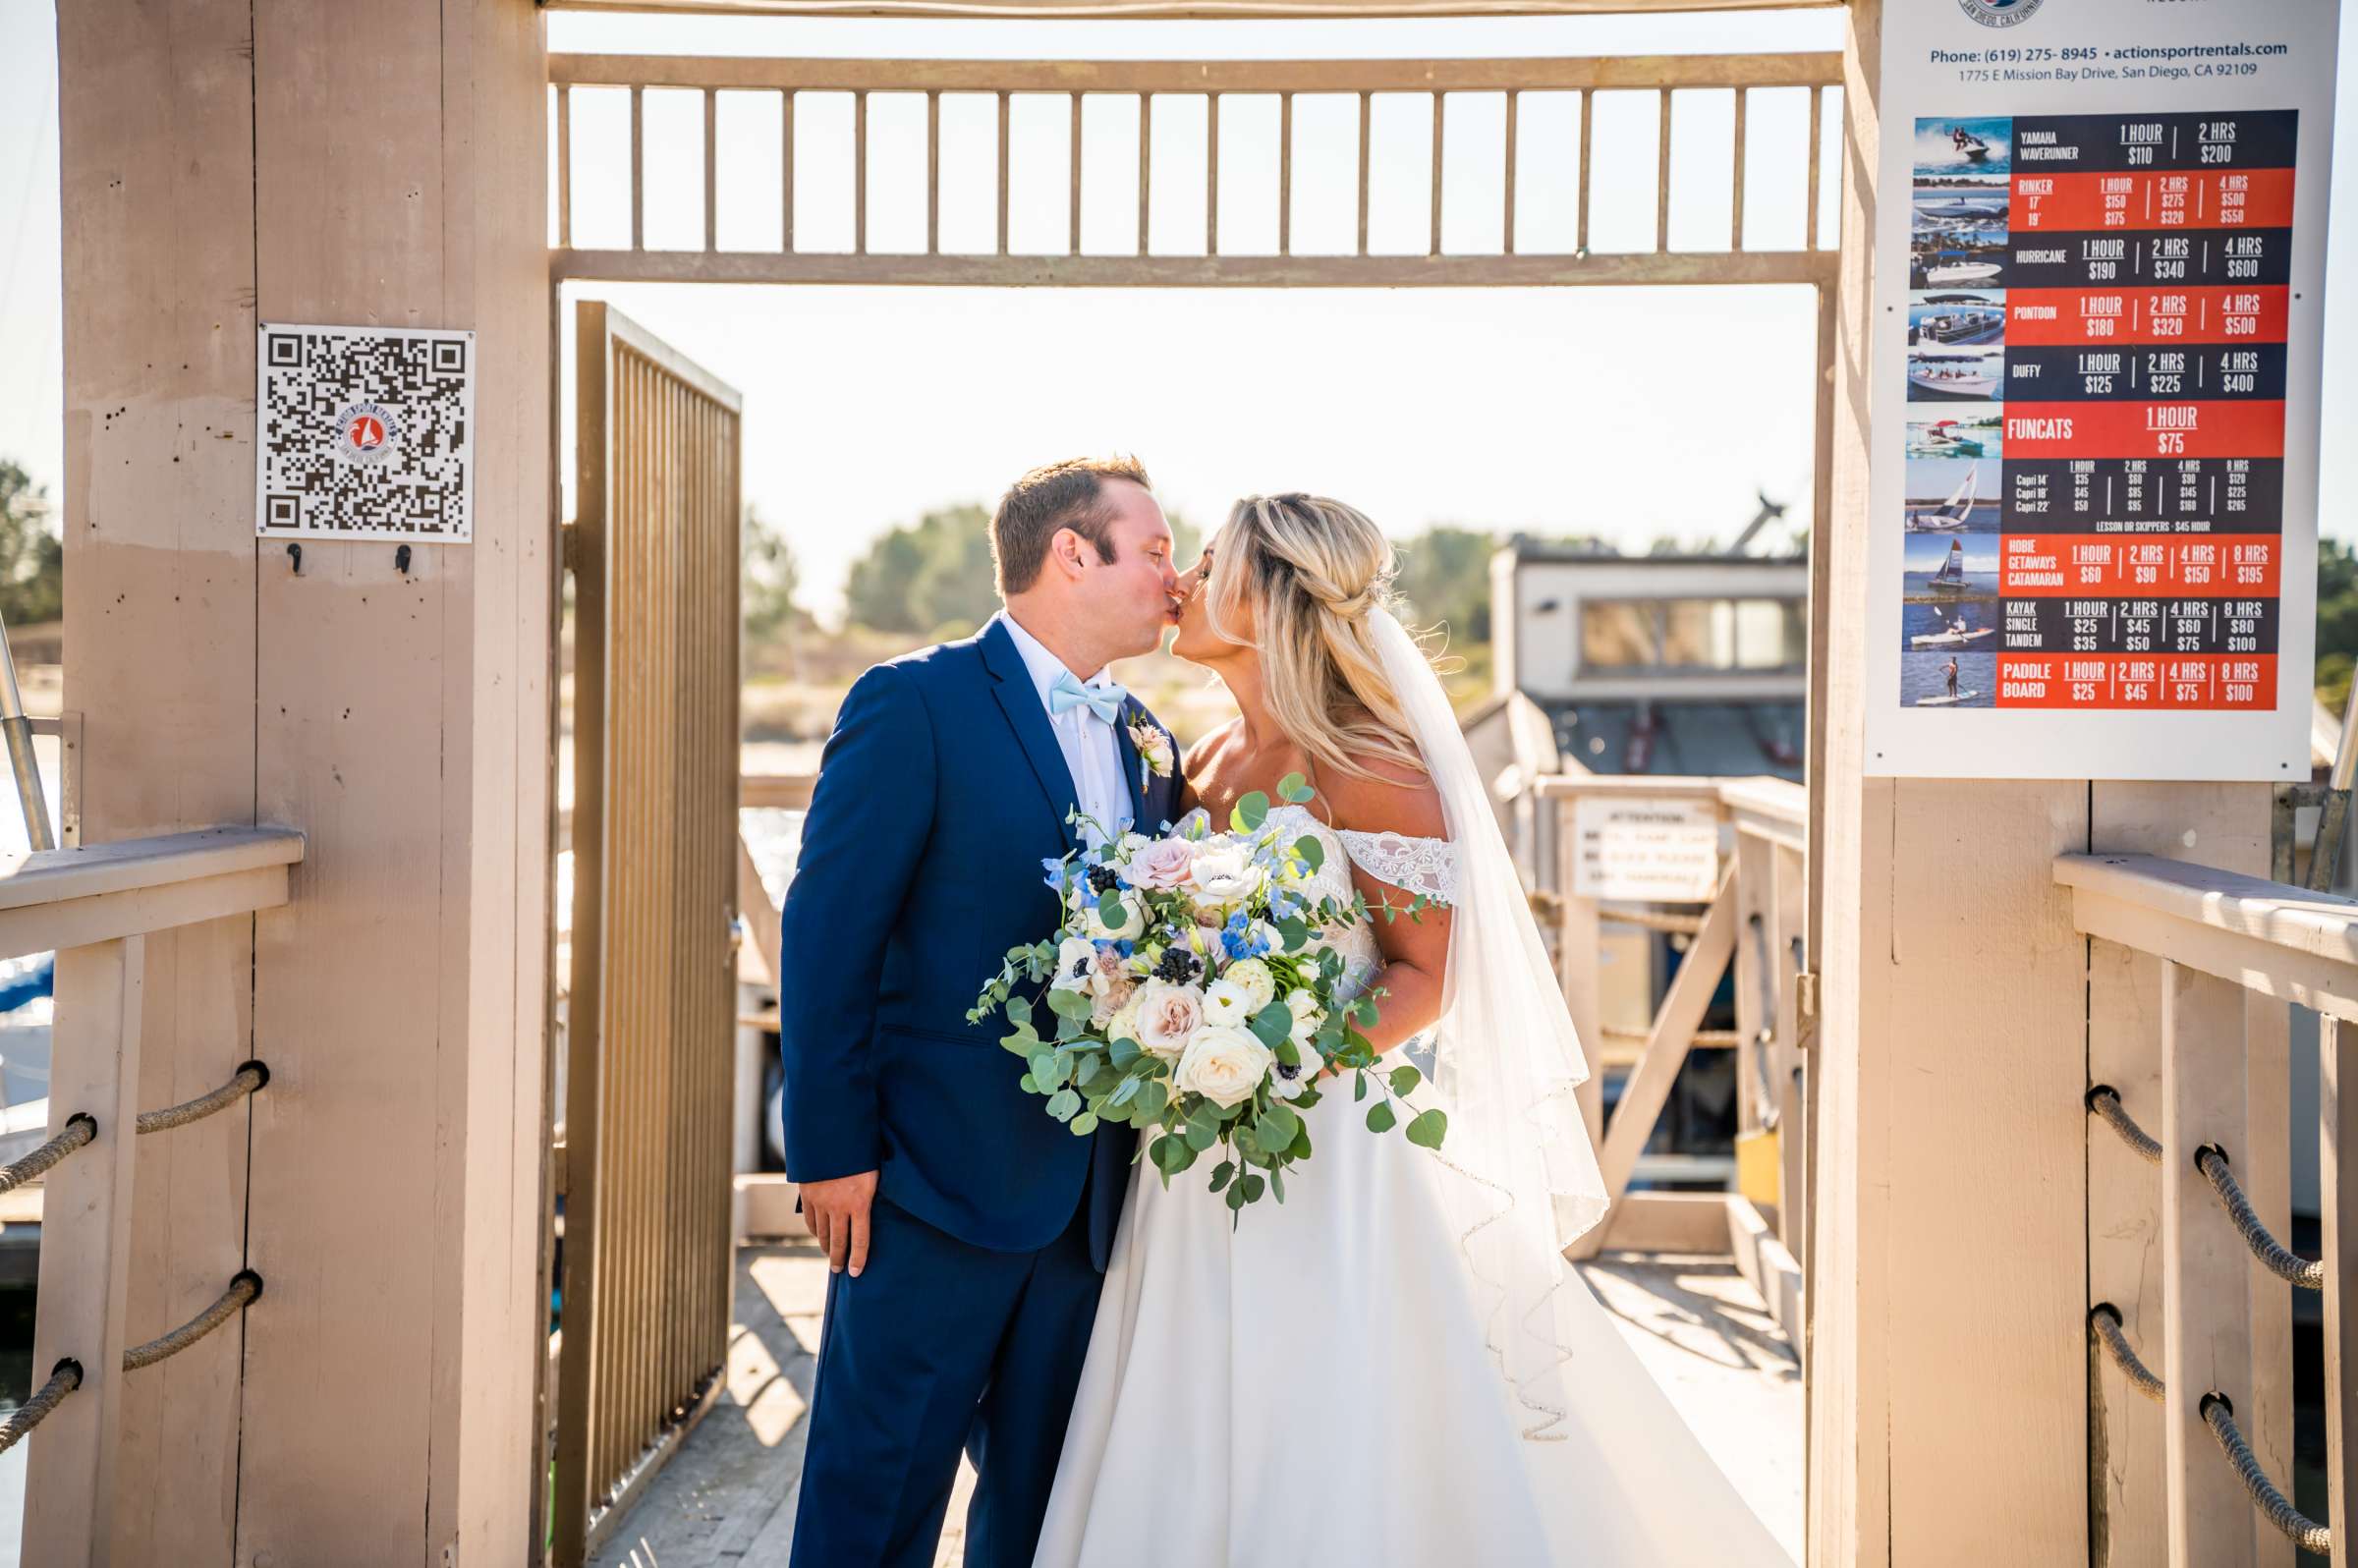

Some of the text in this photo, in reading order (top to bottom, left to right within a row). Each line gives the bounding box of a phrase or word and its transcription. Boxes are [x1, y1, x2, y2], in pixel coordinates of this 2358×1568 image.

[1930, 42, 2287, 63] Phone: (619) 275- 8945 actionsportrentals.com
[1959, 69, 1990, 82] 1775
[2003, 67, 2052, 81] Mission
[2055, 67, 2078, 82] Bay
[2081, 66, 2118, 81] Drive,
[2121, 65, 2146, 78] San
[2149, 64, 2190, 81] Diego,
[2194, 64, 2213, 77] CA
[2217, 64, 2257, 76] 92109
[2021, 132, 2056, 144] YAMAHA
[2121, 125, 2162, 142] 1 HOUR
[2199, 123, 2235, 140] 2 HRS
[2020, 147, 2078, 160] WAVERUNNER
[2129, 147, 2153, 165] $110
[2201, 145, 2231, 163] $200
[2019, 180, 2052, 193] RINKER
[2107, 178, 2132, 192] HOUR
[2161, 177, 2188, 191] 2 HRS
[2220, 176, 2248, 190] 4 HRS
[2029, 196, 2041, 209] 17'
[2105, 195, 2126, 208] $150
[2162, 194, 2184, 207] $275
[2221, 193, 2244, 206] $500
[2028, 212, 2041, 226] 19'
[2105, 212, 2125, 226] $175
[2161, 210, 2184, 224] $320
[2220, 209, 2243, 223] $550
[2083, 241, 2124, 257] 1 HOUR
[2153, 240, 2189, 256] 2 HRS
[2225, 238, 2262, 254] 4 HRS
[2016, 250, 2066, 263] HURRICANE
[2089, 262, 2115, 279] $190
[2155, 261, 2184, 278] $340
[2228, 260, 2258, 277] $600
[2081, 297, 2122, 314] 1 HOUR
[2150, 297, 2186, 313] 2 HRS
[2223, 295, 2260, 311] 4 HRS
[2015, 307, 2056, 319] PONTOON
[2087, 319, 2113, 337] $180
[2153, 318, 2182, 336] $320
[2225, 317, 2256, 335] $500
[2079, 355, 2120, 371] 1 HOUR
[2148, 354, 2185, 370] 2 HRS
[2221, 353, 2258, 369] 4 HRS
[2013, 364, 2041, 378] DUFFY
[2085, 376, 2112, 393] $125
[2151, 375, 2180, 392] $225
[2223, 375, 2254, 392] $400
[2147, 408, 2197, 427] 1 HOUR
[2008, 419, 2073, 439] FUNCATS
[2159, 434, 2184, 454] $75
[2075, 461, 2095, 472] HOUR
[2133, 461, 2147, 472] HRS
[2186, 461, 2200, 472] HRS
[2234, 461, 2249, 472] HRS
[2097, 521, 2210, 532] LESSON OR SKIPPERS $45 HOUR
[2009, 539, 2035, 553] HOBIE
[2072, 546, 2110, 562] 1 HOUR
[2130, 546, 2163, 562] 2 HRS
[2181, 546, 2215, 562] 4 HRS
[2234, 546, 2268, 562] 8 HRS
[2008, 557, 2056, 570] GETAWAYS
[2008, 573, 2063, 587] CATAMARAN
[2081, 567, 2101, 584] $60
[2136, 567, 2157, 584] $90
[2185, 567, 2210, 584] $150
[2238, 567, 2263, 584] $195
[2006, 602, 2036, 614] KAYAK
[2065, 602, 2107, 616] 1 HOUR
[2120, 602, 2158, 616] 2 HRS
[2170, 602, 2208, 616] 4 HRS
[2224, 602, 2262, 616] 8 HRS
[2006, 618, 2037, 631] SINGLE
[2074, 619, 2098, 634] $25
[2127, 619, 2150, 634] $45
[2177, 619, 2200, 634] $60
[2230, 619, 2254, 634] $80
[2005, 634, 2042, 647] TANDEM
[2073, 637, 2097, 650] $35
[2126, 637, 2150, 650] $50
[2177, 637, 2200, 650] $75
[2228, 637, 2256, 651] $100
[2003, 664, 2051, 679] PADDLE
[2064, 663, 2105, 680] 1 HOUR
[2119, 663, 2155, 680] 2 HRS
[2169, 663, 2206, 680] 4 HRS
[2221, 663, 2258, 680] 8 HRS
[2003, 683, 2046, 698] BOARD
[2073, 684, 2095, 700] $25
[2125, 684, 2148, 700] $45
[2177, 684, 2198, 700] $75
[2226, 684, 2253, 700] $100
